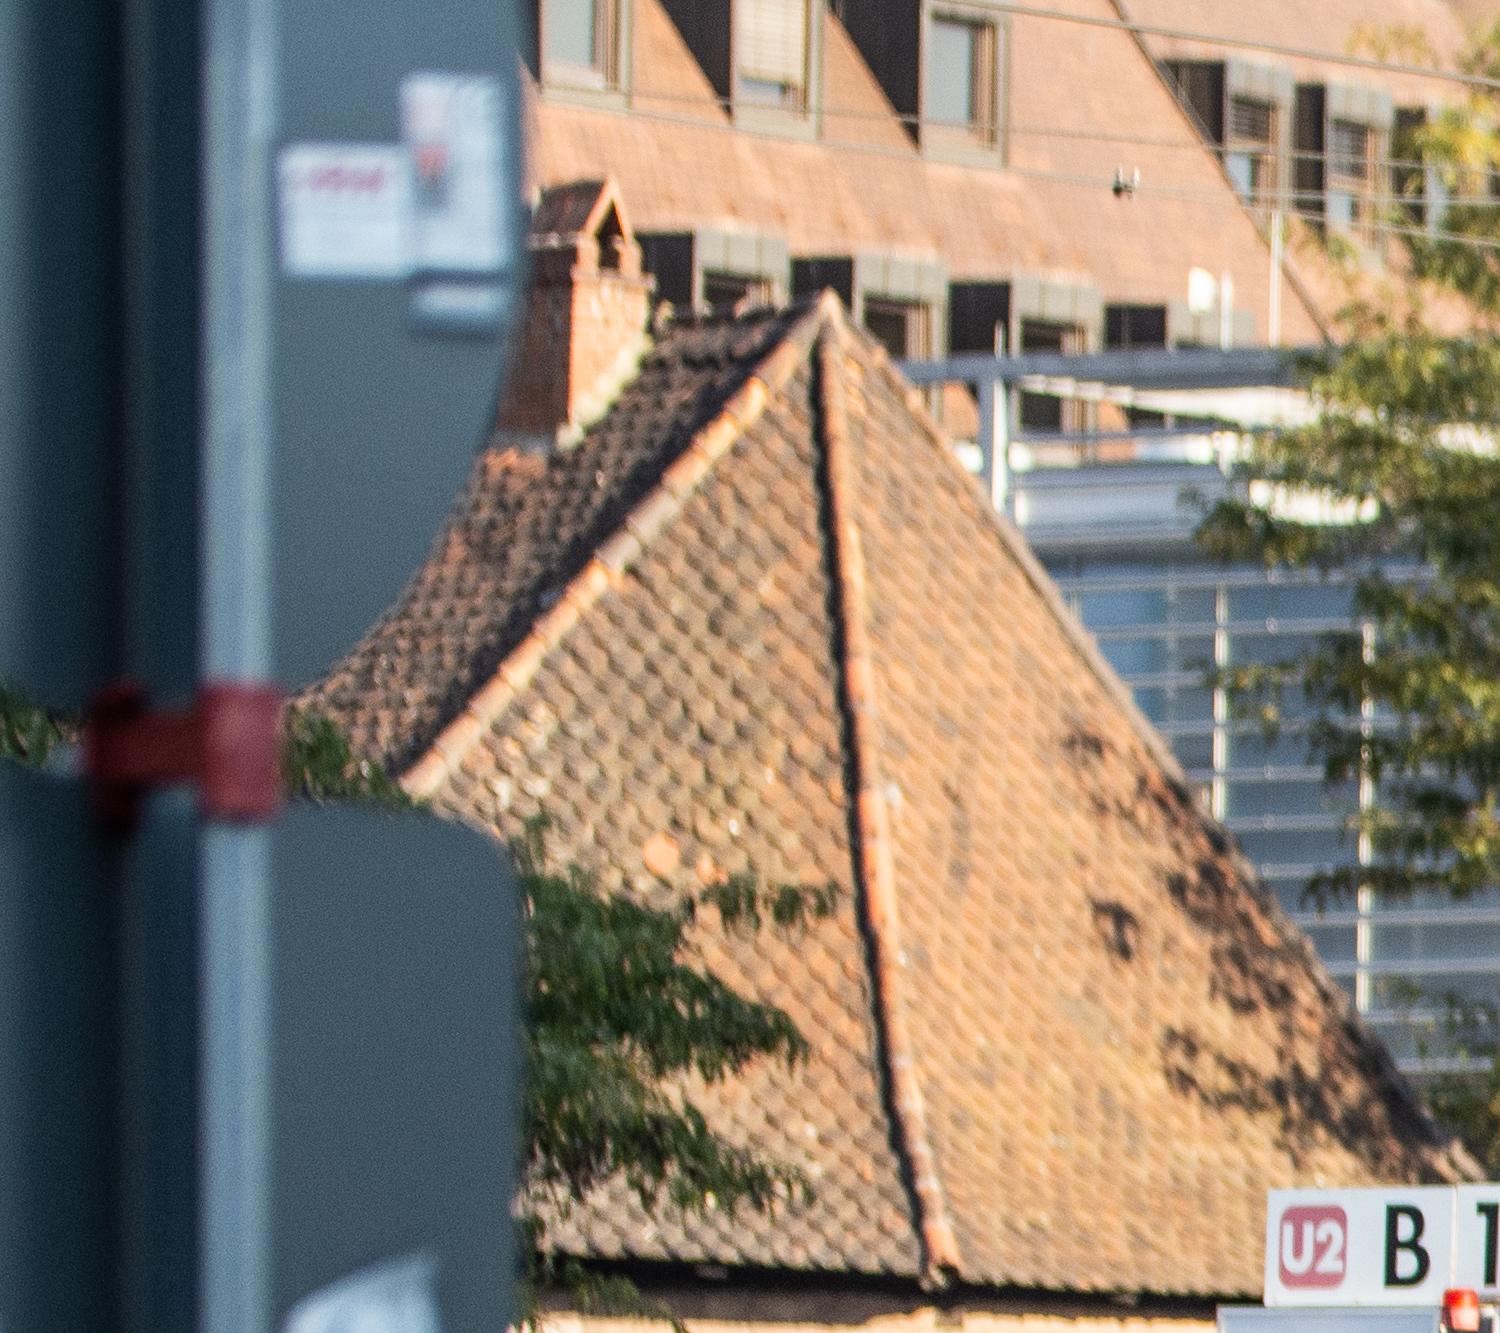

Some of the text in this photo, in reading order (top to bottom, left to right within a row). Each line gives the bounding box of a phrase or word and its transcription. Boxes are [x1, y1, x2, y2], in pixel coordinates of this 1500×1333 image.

[1282, 1219, 1345, 1275] U2
[1384, 1203, 1430, 1289] B
[1476, 1202, 1500, 1289] 1
